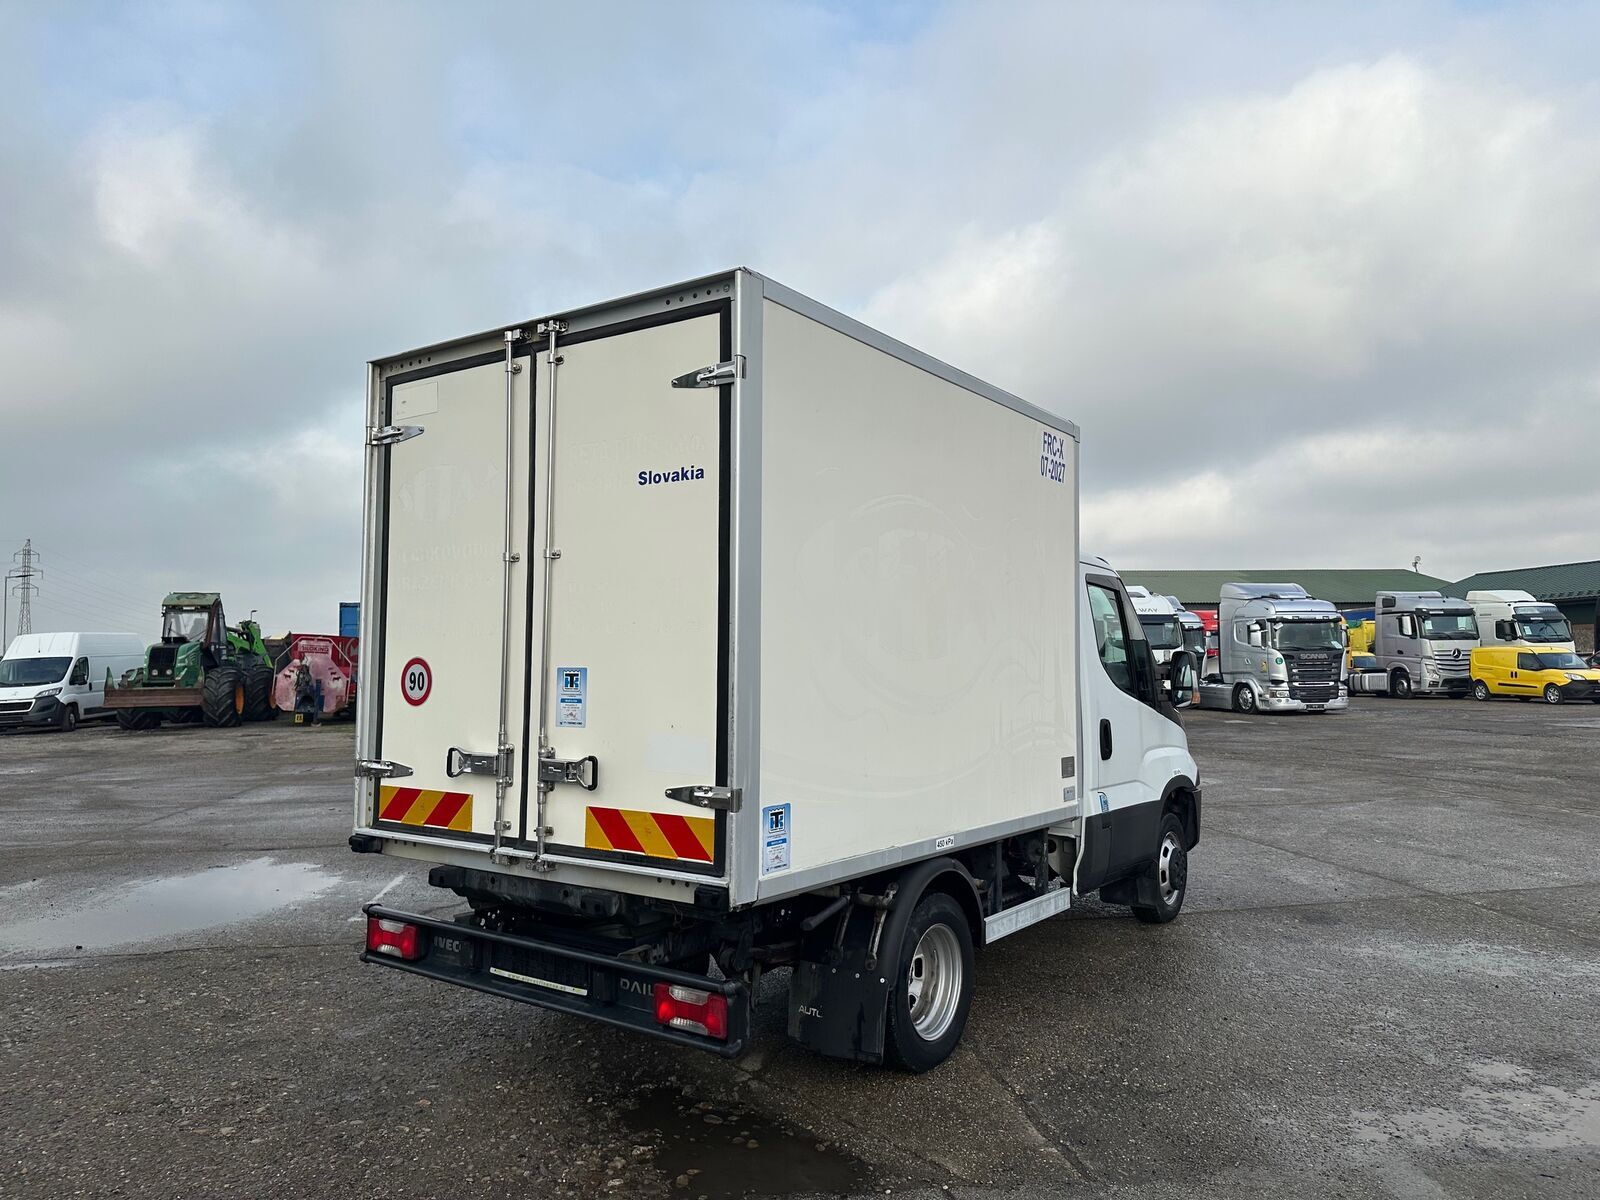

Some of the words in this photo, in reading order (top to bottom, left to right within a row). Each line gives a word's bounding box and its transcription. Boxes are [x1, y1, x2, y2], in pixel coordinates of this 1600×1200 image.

[1043, 431, 1064, 460] FRC-X
[638, 465, 704, 486] Slovakia
[1040, 455, 1066, 484] 07-2027
[409, 671, 425, 691] 90
[937, 839, 945, 848] 450
[620, 977, 655, 997] DAIL
